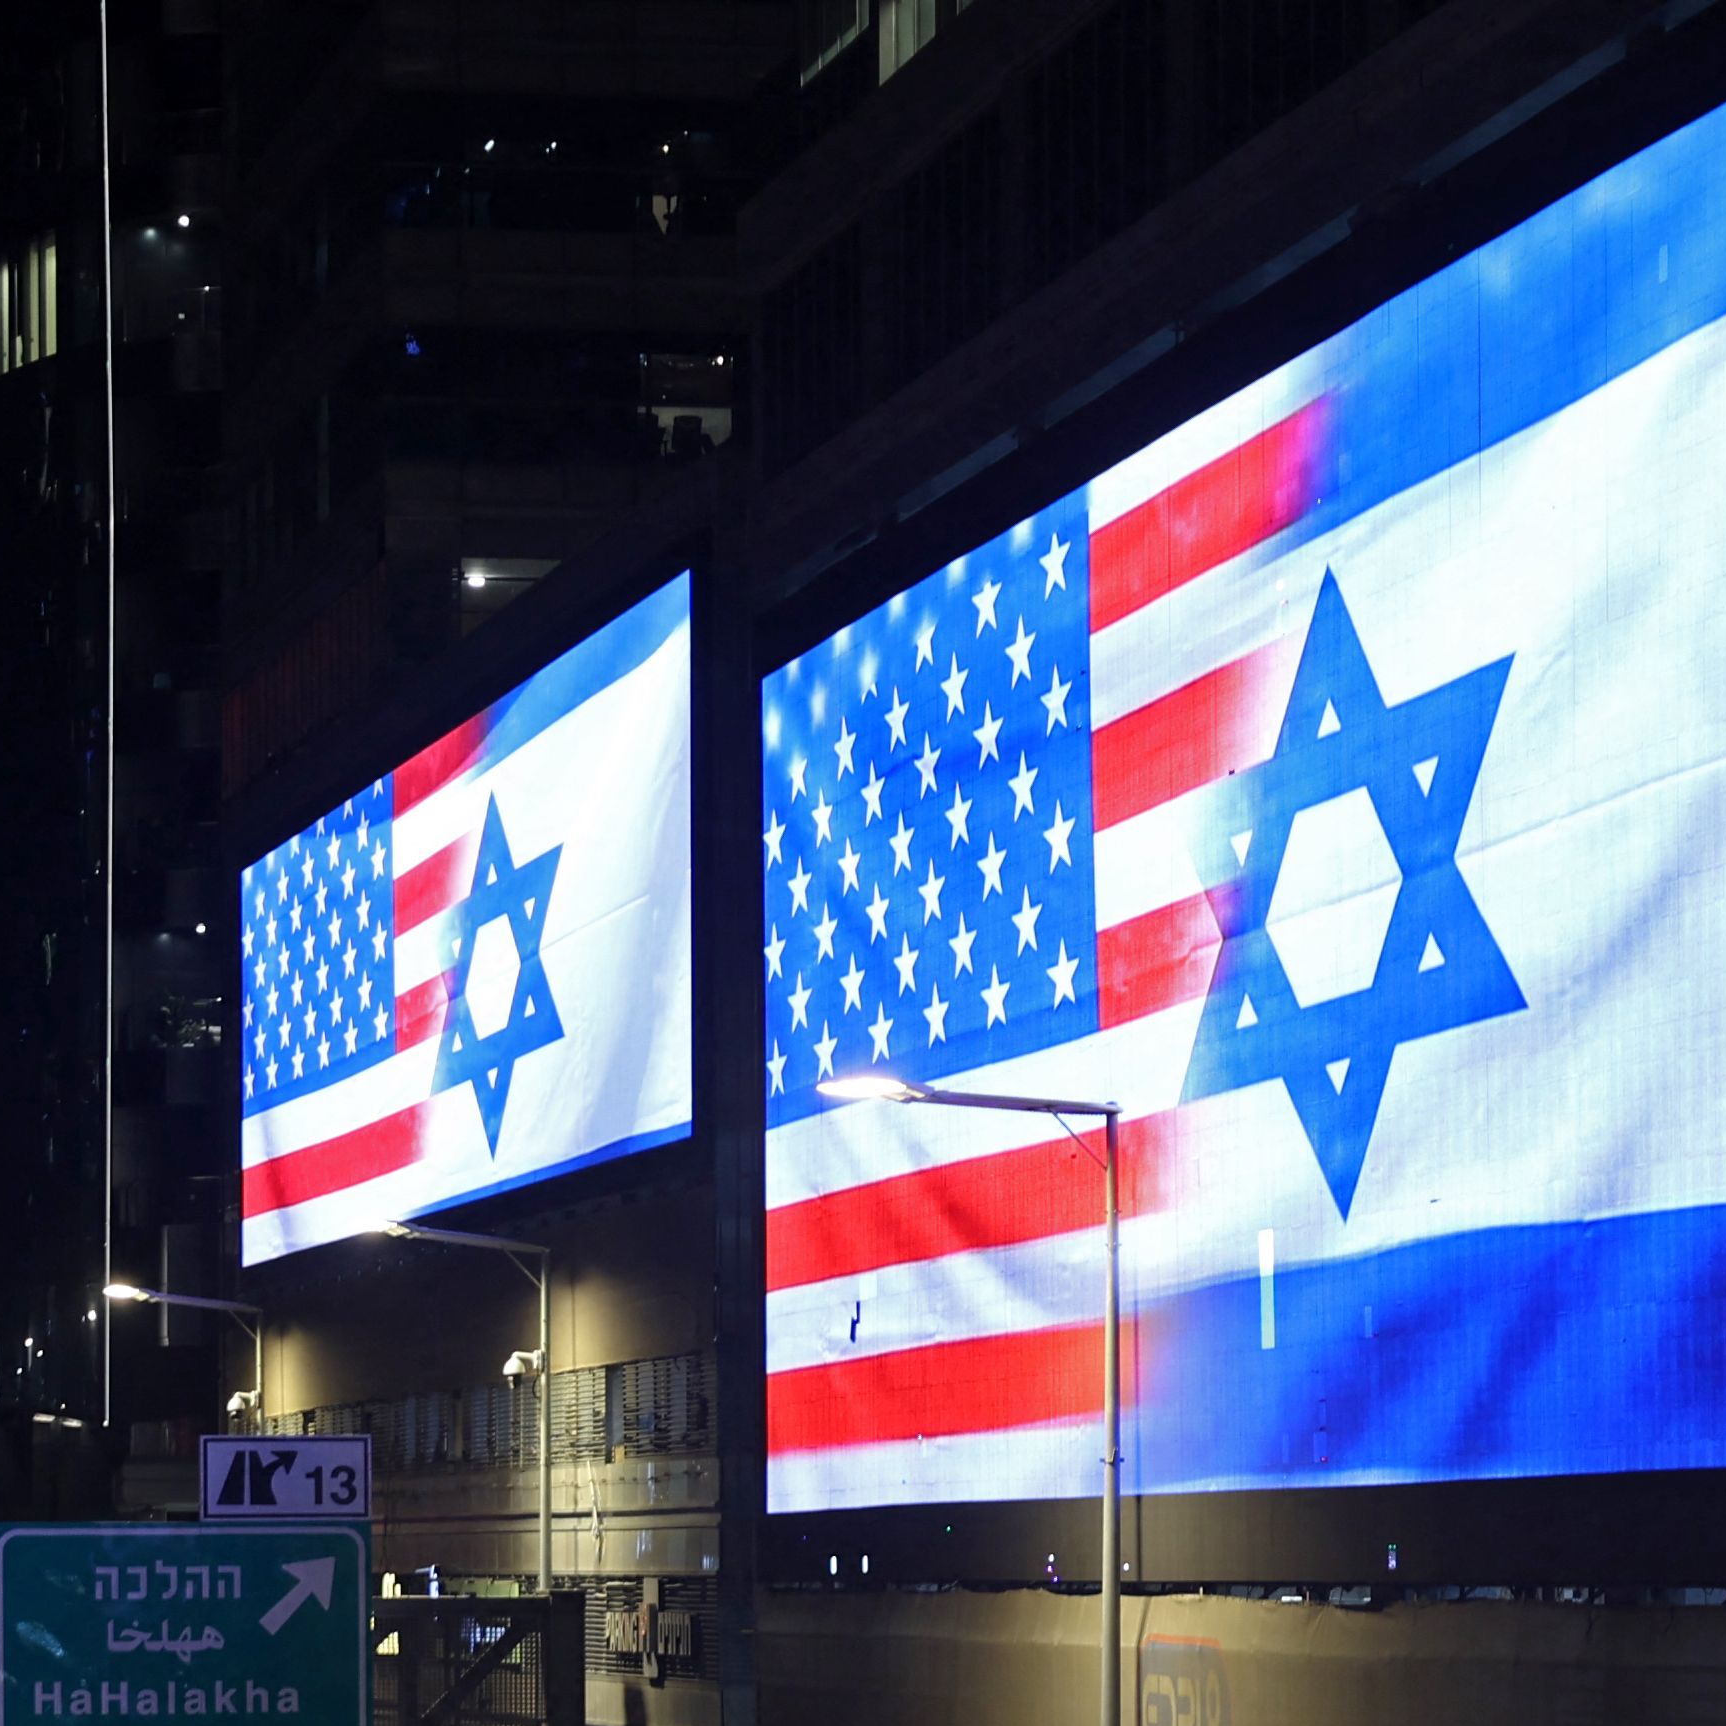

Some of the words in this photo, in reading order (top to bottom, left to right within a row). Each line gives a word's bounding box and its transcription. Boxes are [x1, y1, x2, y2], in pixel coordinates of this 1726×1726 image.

[305, 1466, 357, 1505] 13
[95, 1560, 241, 1600] ההלכה
[107, 1619, 225, 1663] ههلخا
[606, 1611, 638, 1653] PARKING
[34, 1680, 300, 1715] HaHalakha
